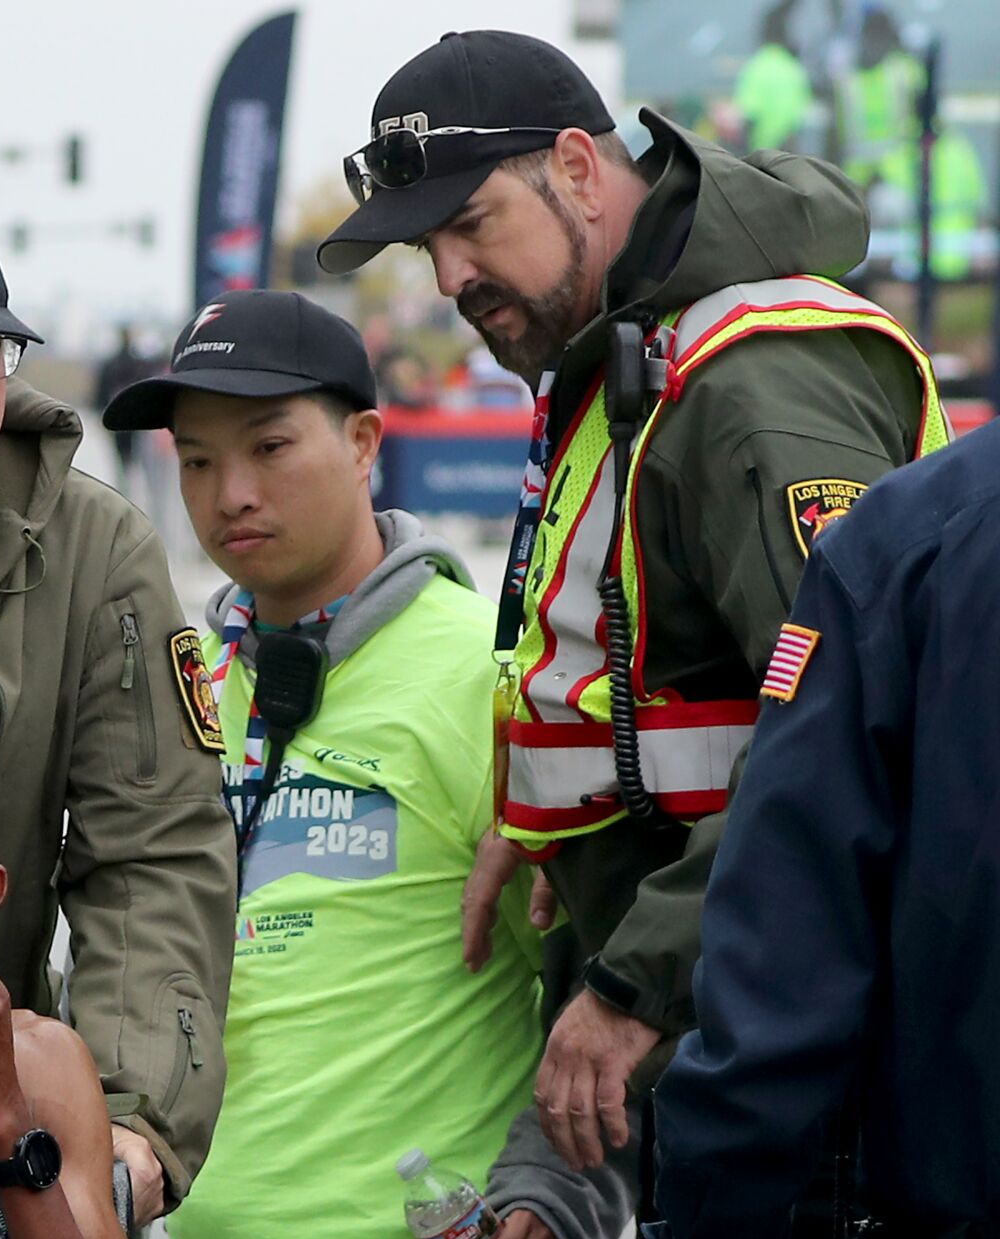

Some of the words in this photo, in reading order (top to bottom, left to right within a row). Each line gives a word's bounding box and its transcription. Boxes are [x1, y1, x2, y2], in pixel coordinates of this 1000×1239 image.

[378, 111, 429, 136] FD
[795, 485, 820, 501] LOS
[824, 496, 852, 508] FIRE
[306, 822, 389, 860] 2023
[256, 919, 313, 932] MARATHON
